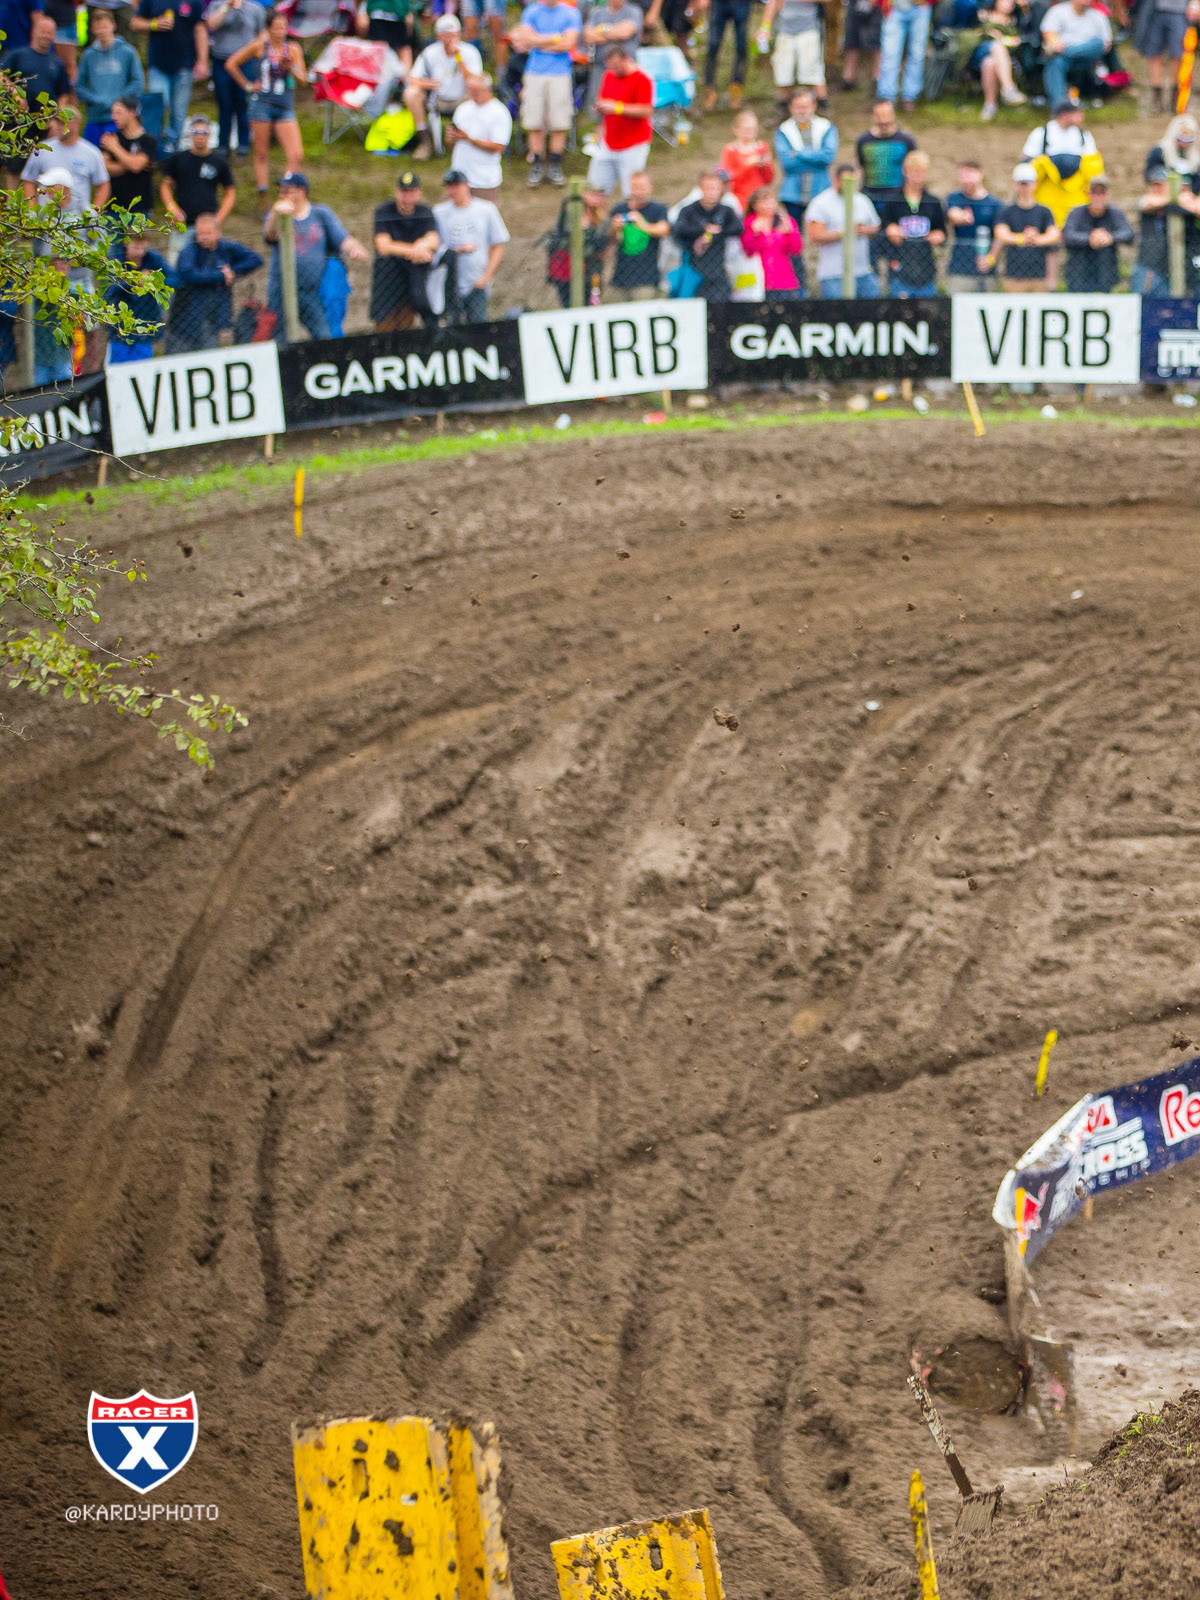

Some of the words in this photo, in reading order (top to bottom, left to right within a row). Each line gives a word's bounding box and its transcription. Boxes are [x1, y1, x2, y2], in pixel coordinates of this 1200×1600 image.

[545, 314, 679, 384] VIRB
[978, 308, 1112, 368] VIRB
[129, 361, 256, 436] VIRB
